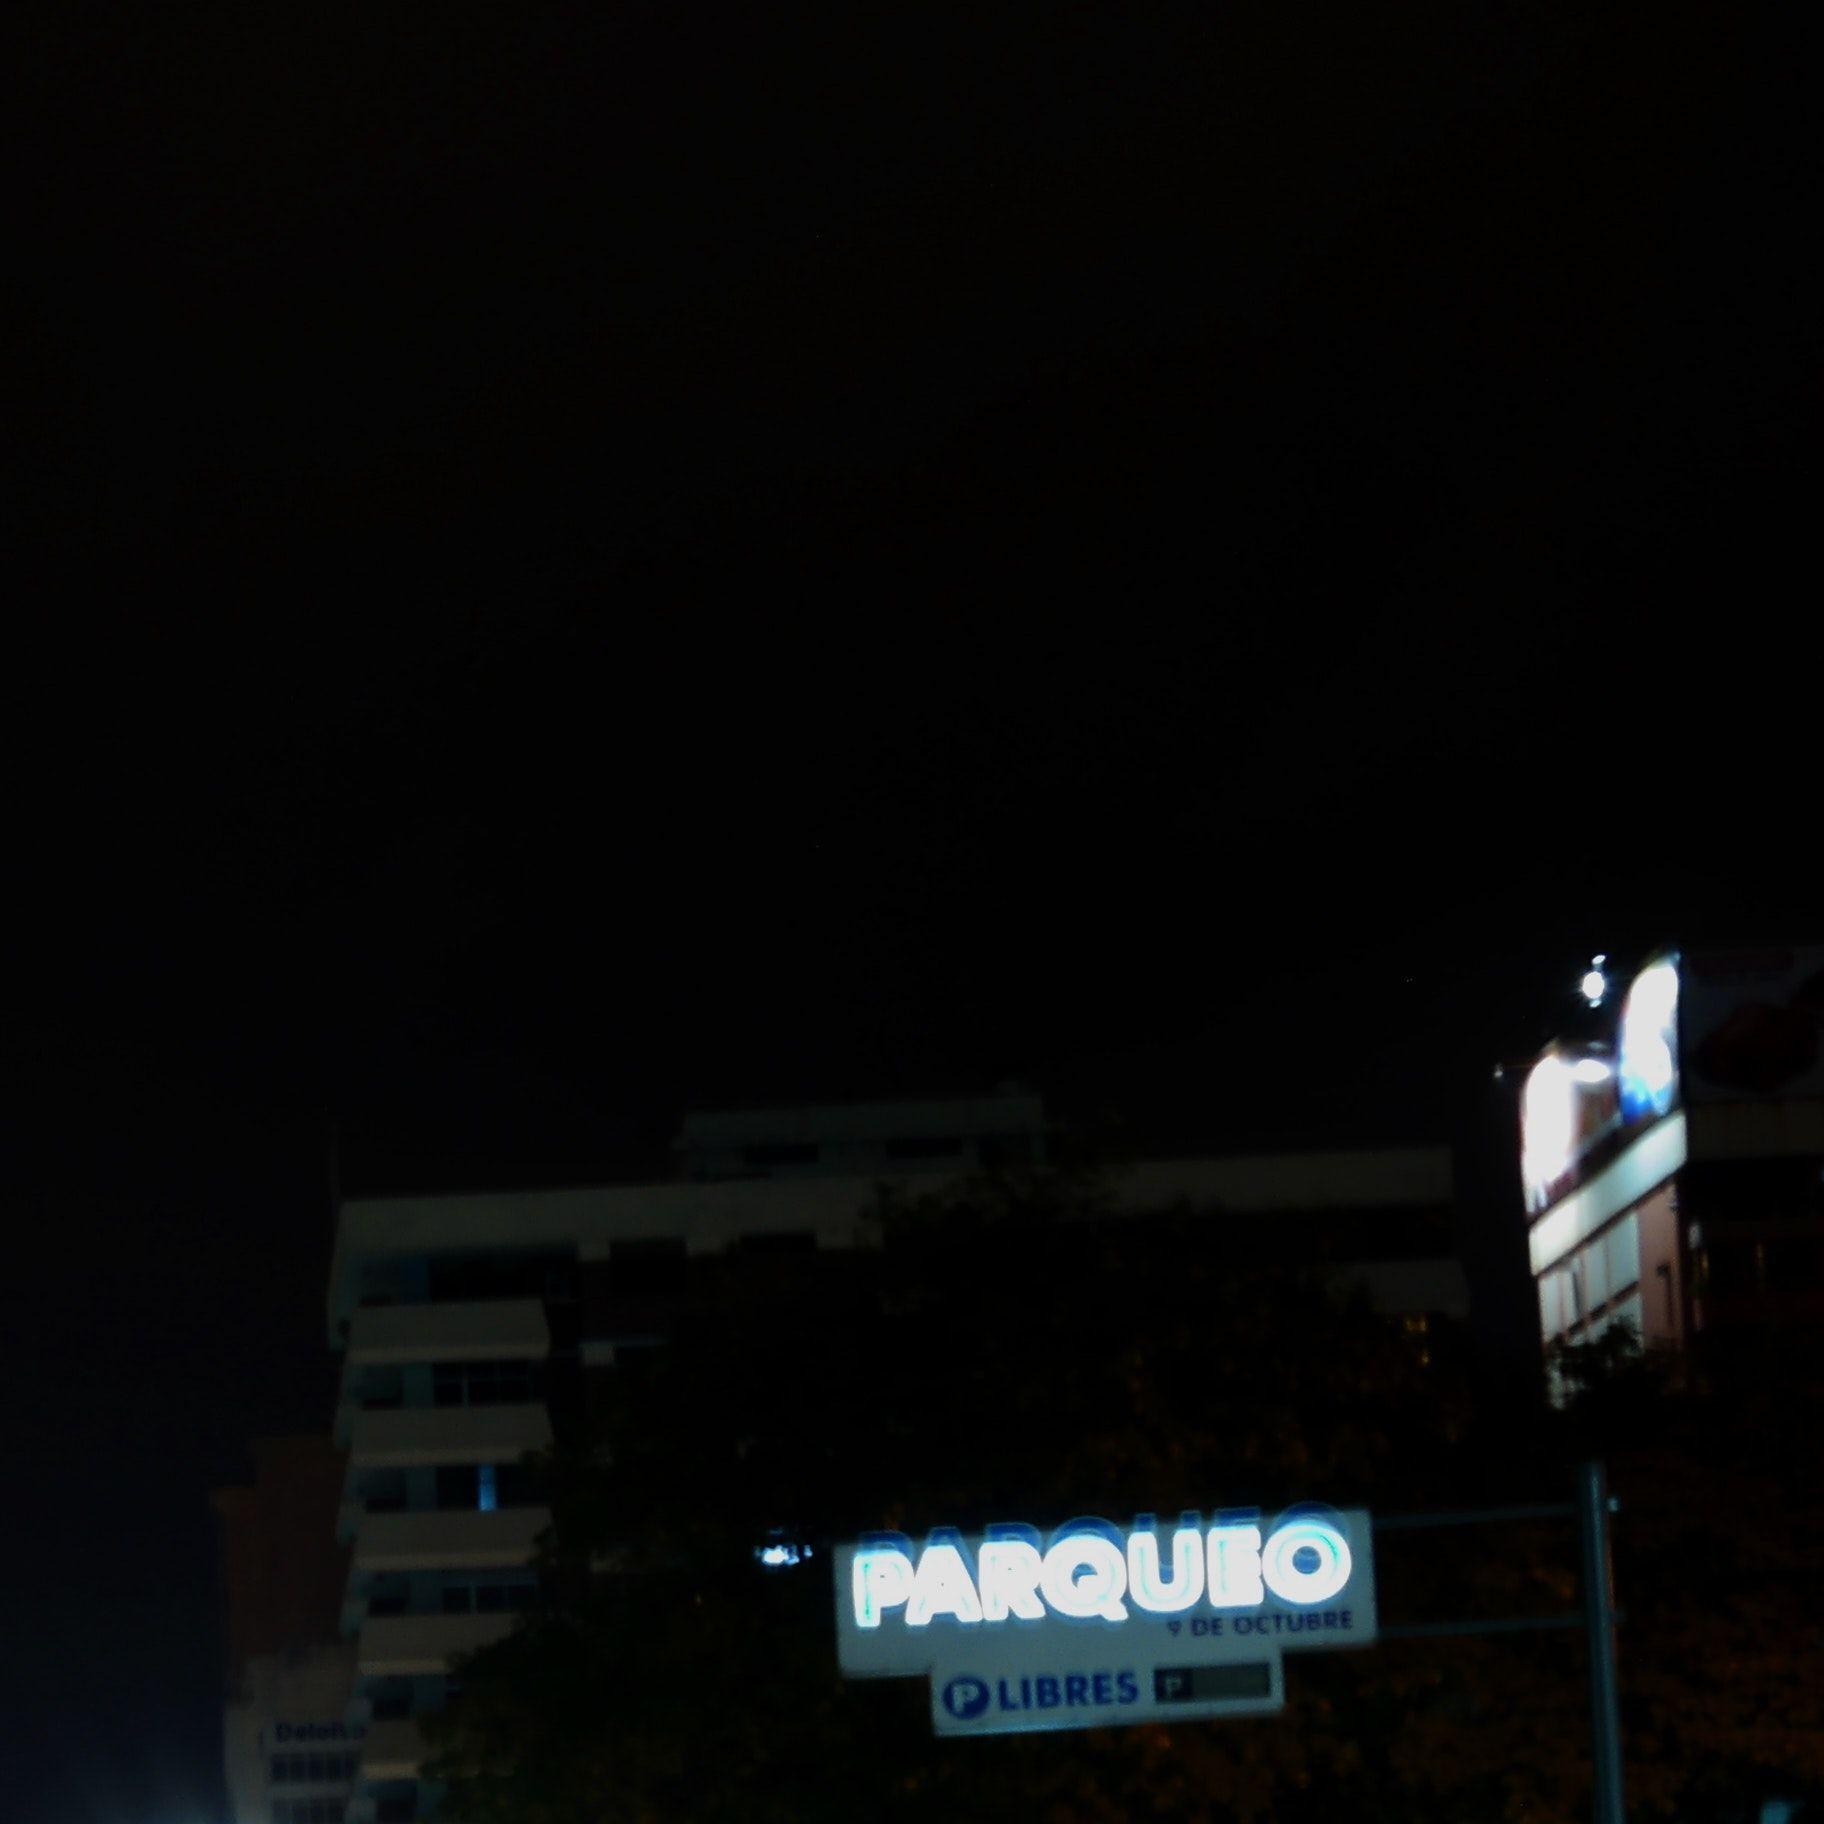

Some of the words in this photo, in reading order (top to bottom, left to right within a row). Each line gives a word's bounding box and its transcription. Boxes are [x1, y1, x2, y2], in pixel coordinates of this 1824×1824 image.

[853, 1515, 1352, 1627] PARQUEO
[1167, 1619, 1182, 1637] 9
[1191, 1617, 1223, 1637] DE
[1233, 1610, 1353, 1635] OCTUBRE
[999, 1671, 1138, 1711] LIBRES
